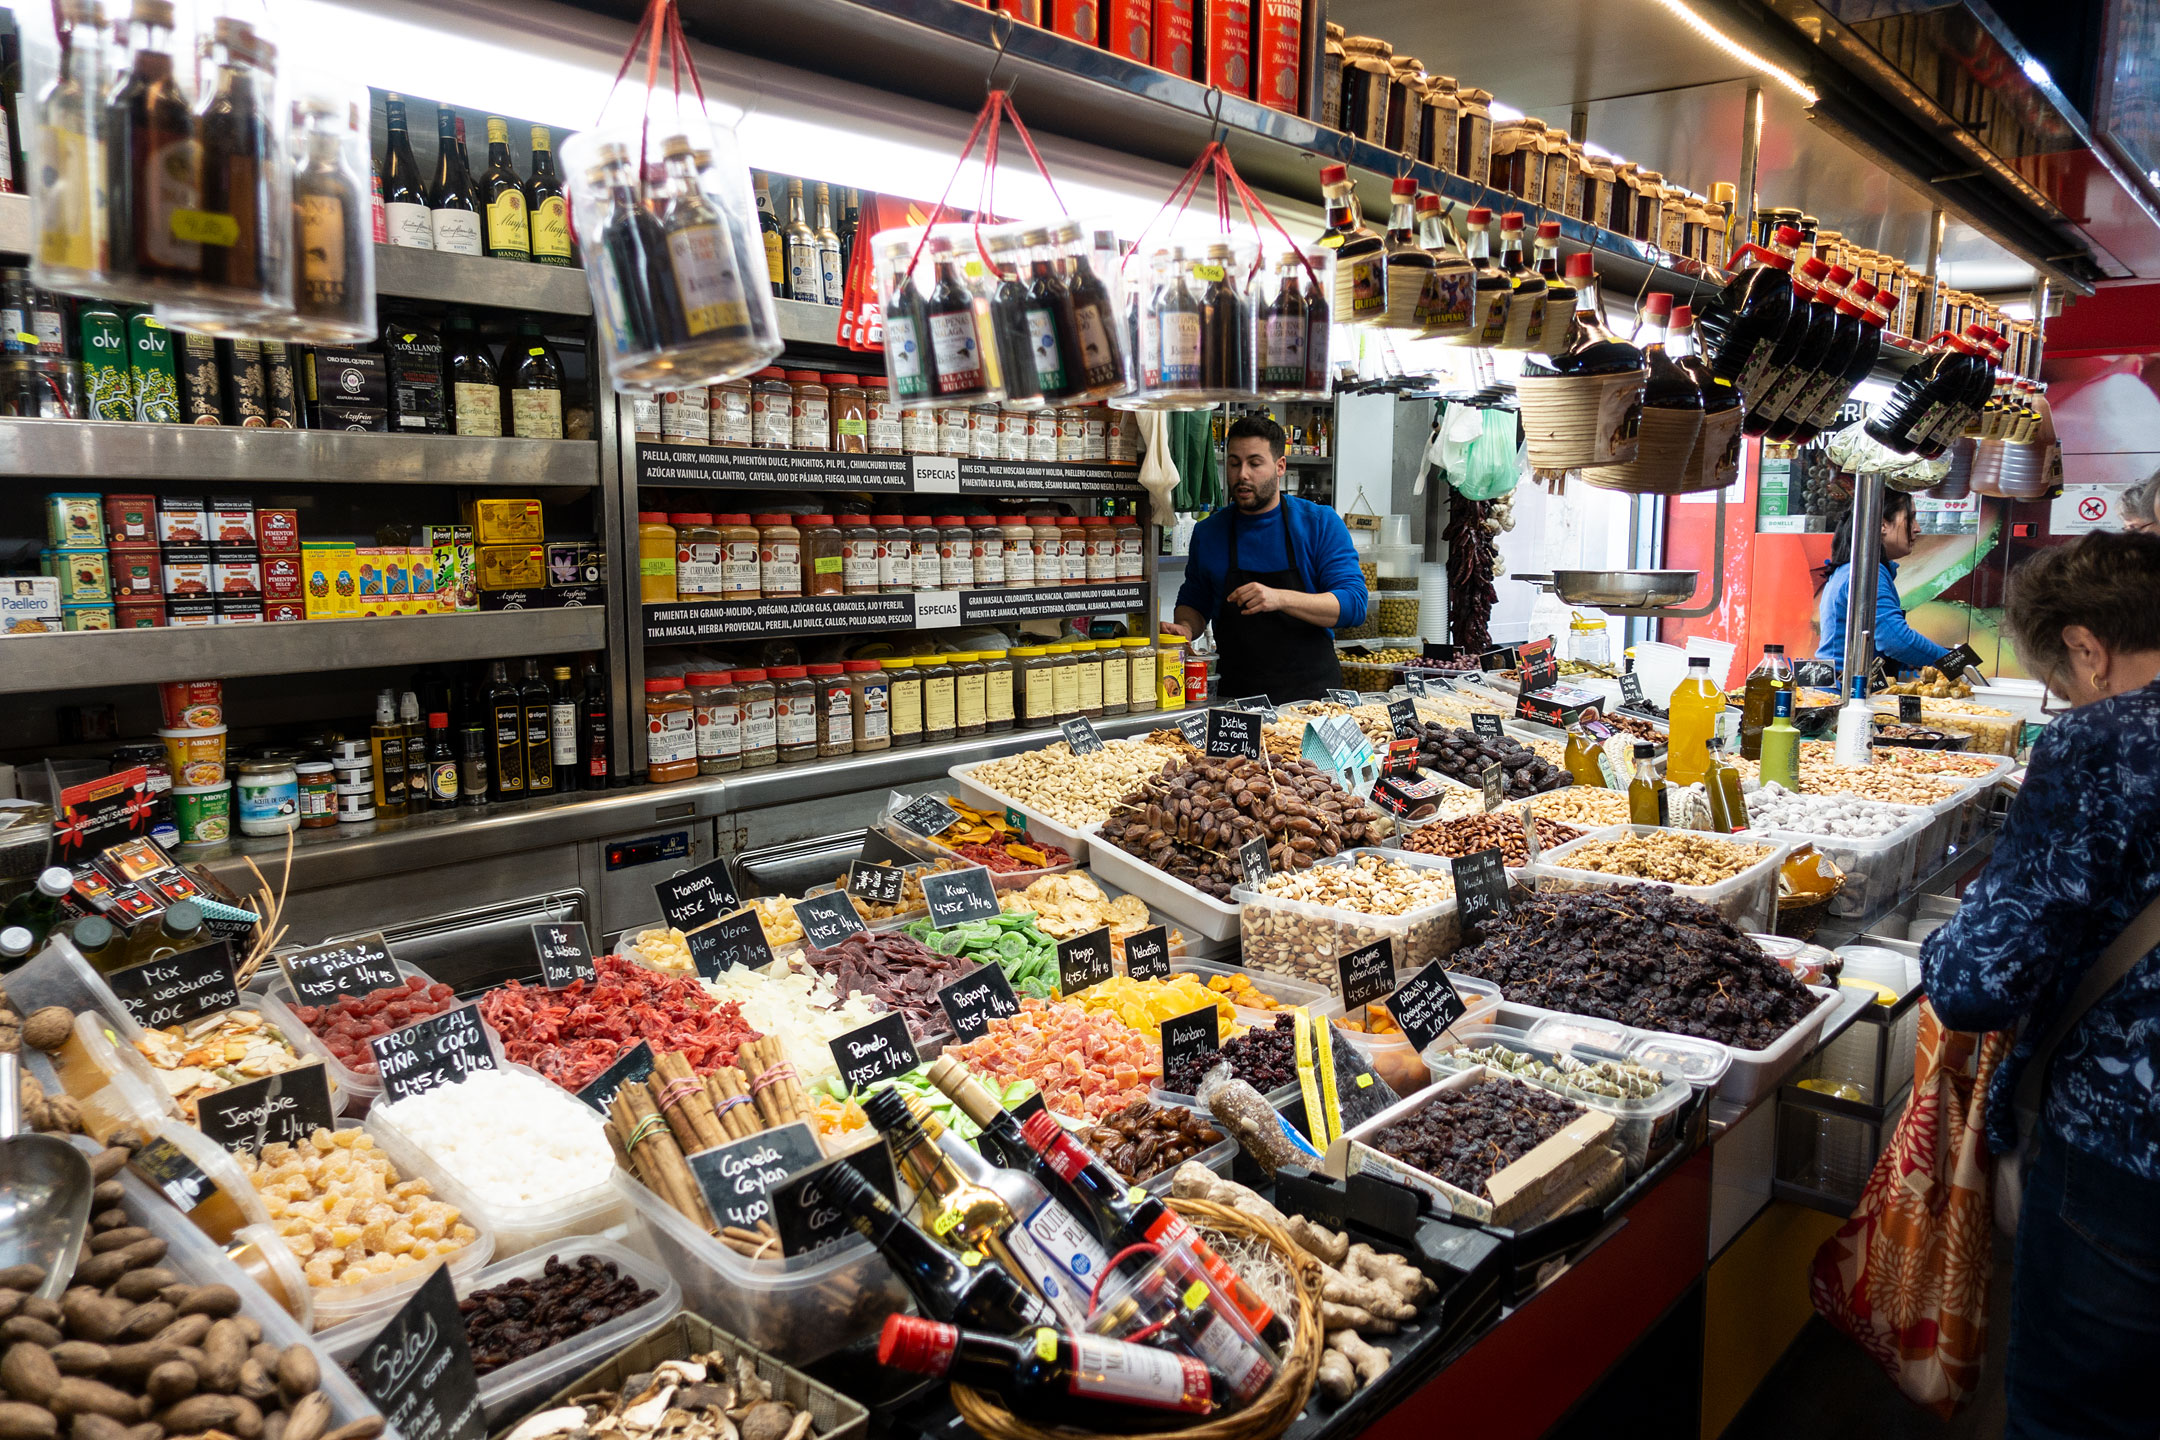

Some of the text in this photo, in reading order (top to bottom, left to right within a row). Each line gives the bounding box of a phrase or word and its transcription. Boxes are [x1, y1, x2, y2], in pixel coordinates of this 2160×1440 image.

[92, 328, 121, 349] olv
[138, 331, 166, 352] olv
[642, 450, 672, 463] PAELLA,
[672, 452, 698, 464] CURRY,
[698, 453, 732, 466] MORUNA,
[732, 454, 768, 466] PIMENTÓN
[768, 457, 790, 468] DULCE,
[791, 457, 826, 469] PINCHITOS,
[826, 459, 836, 468] PIL
[646, 465, 676, 478] AZÚCAR
[676, 468, 711, 481] VAINILLA,
[711, 470, 747, 482] CILANTRO,
[749, 471, 776, 483] CAYENA,
[790, 474, 799, 483] DE
[825, 474, 846, 485] FUEGO,
[847, 475, 862, 485] LINO,
[863, 475, 883, 486] CLAVO,
[883, 476, 906, 486] CANELA,
[916, 468, 956, 480] ESPECIAS
[2, 597, 48, 613] Paellero
[654, 610, 689, 621] PIMIENTA
[689, 609, 699, 619] EN
[757, 604, 790, 616] ORÉGANO,
[790, 601, 815, 613] AZÚCAR
[815, 601, 832, 612] GLAS,
[833, 600, 867, 612] CARACOLES,
[918, 604, 957, 616] ESPECIAS
[647, 627, 665, 638] TIKA
[665, 625, 697, 637] MASALA,
[698, 623, 724, 634] HIERBA
[724, 621, 765, 633] PROVENZAL,
[765, 619, 792, 630] PEREJIL,
[803, 618, 824, 628] DULCE,
[824, 617, 848, 628] CALLOS,
[848, 615, 867, 626] POLLO
[888, 613, 913, 624] PESCADO
[191, 738, 219, 747] AROY-D
[671, 876, 714, 900] Manzana
[944, 882, 969, 897] Kiwi
[691, 924, 751, 955] Aloe Vera
[287, 949, 348, 970] Fresas
[1068, 945, 1095, 965] Mango
[141, 964, 181, 987] Mix
[152, 969, 226, 1002] verduras
[953, 983, 991, 1008] Papaya
[378, 1049, 420, 1079] PIÑA
[436, 1026, 481, 1055] COCO
[218, 1095, 300, 1129] Jengibre
[720, 1145, 784, 1178] Canela
[733, 1166, 789, 1196] Ceylan
